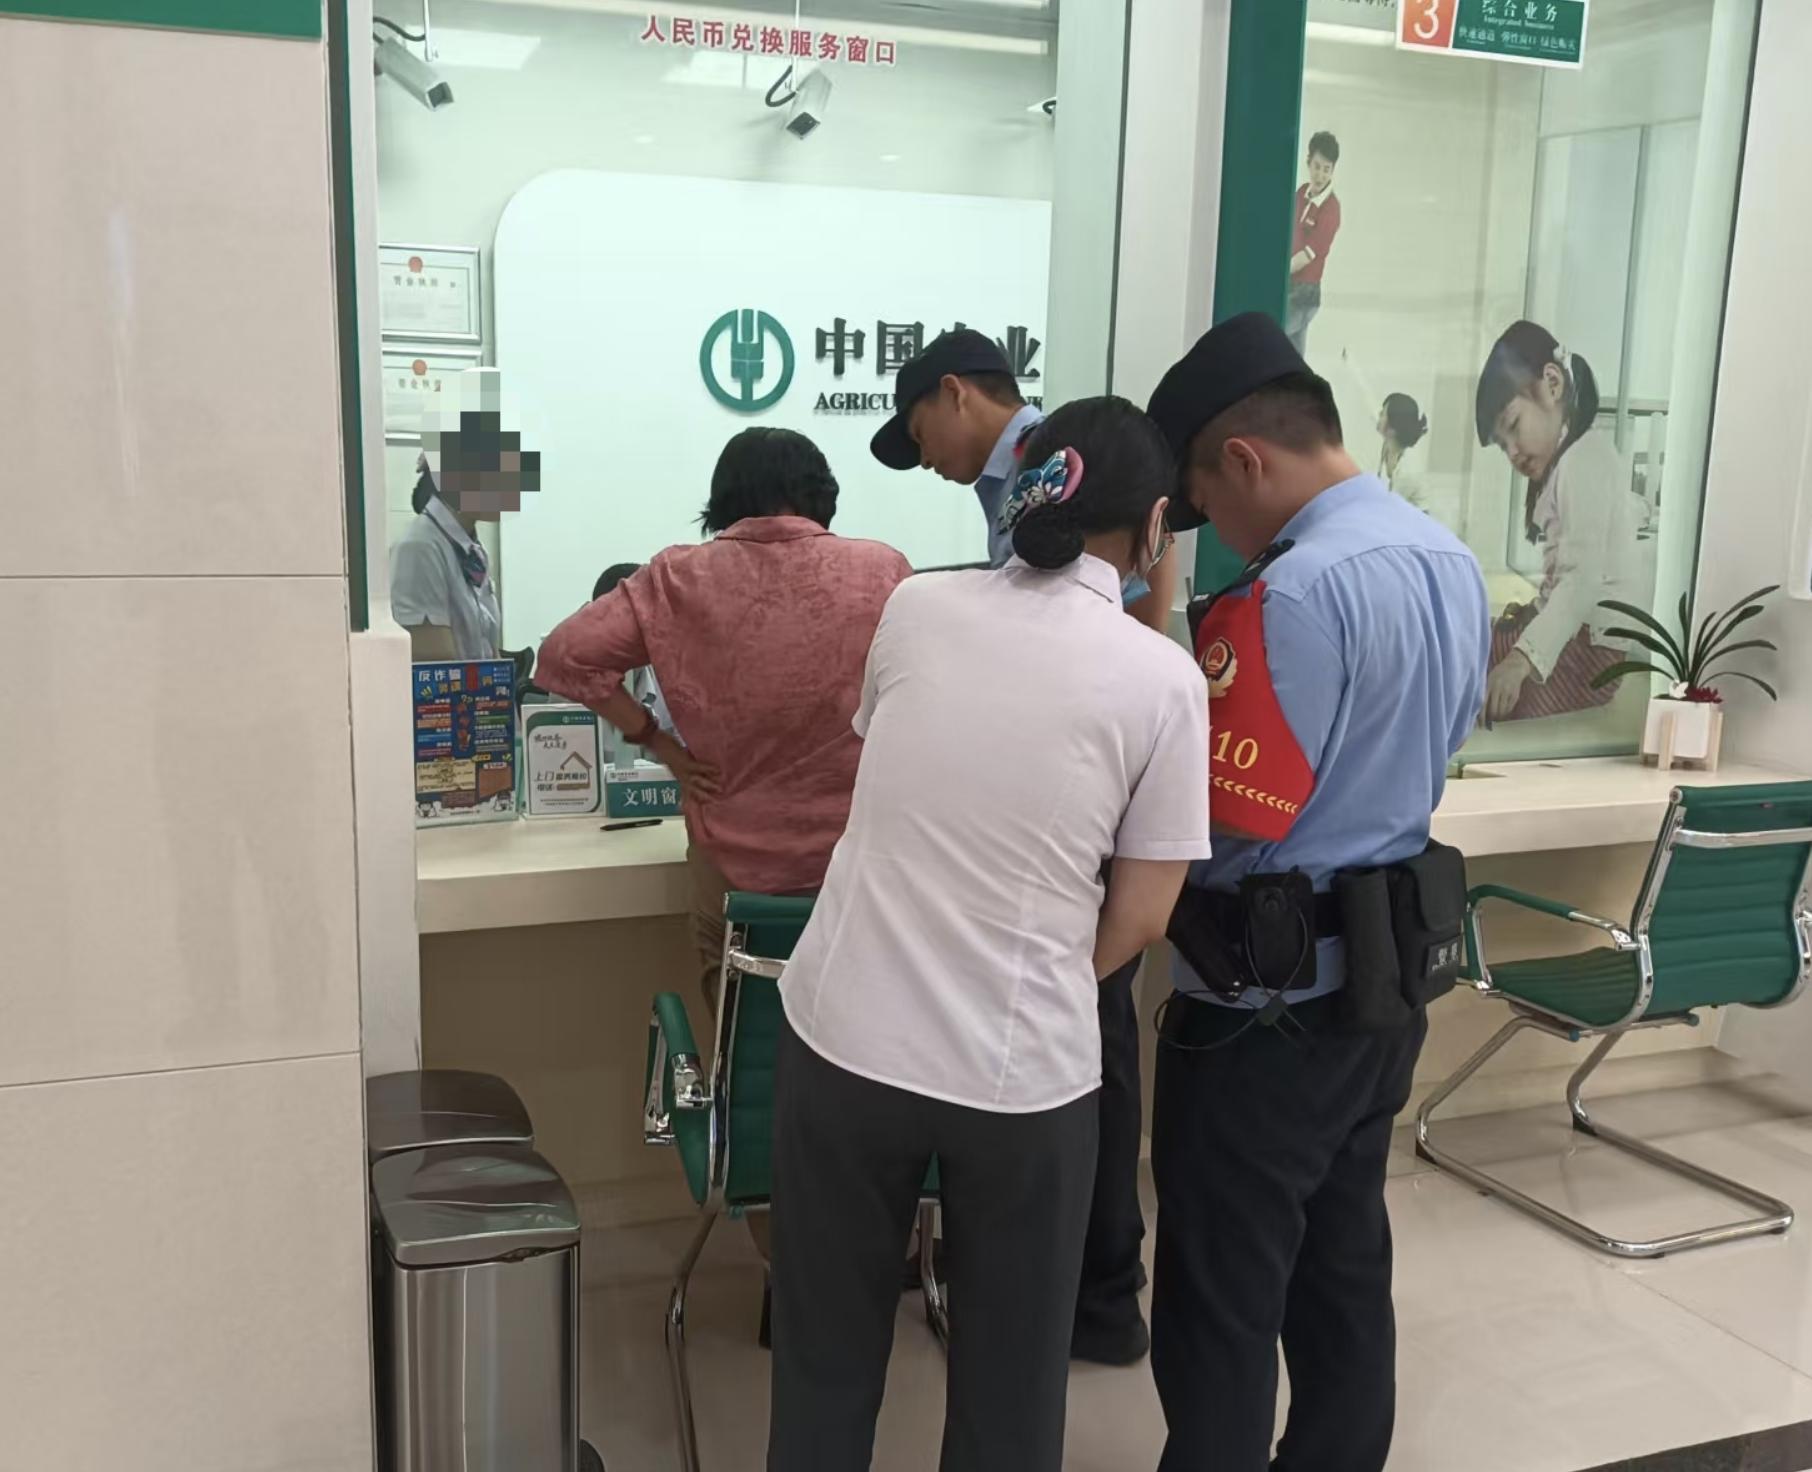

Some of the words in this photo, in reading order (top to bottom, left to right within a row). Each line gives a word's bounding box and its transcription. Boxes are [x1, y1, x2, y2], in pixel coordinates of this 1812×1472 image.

[641, 15, 896, 63] 人民币兑换服务窗口
[1413, 0, 1439, 40] 3
[815, 316, 1041, 378] 中国业
[813, 392, 897, 410] AGRICU
[1210, 726, 1259, 770] 10
[623, 786, 677, 807] 文明窗
